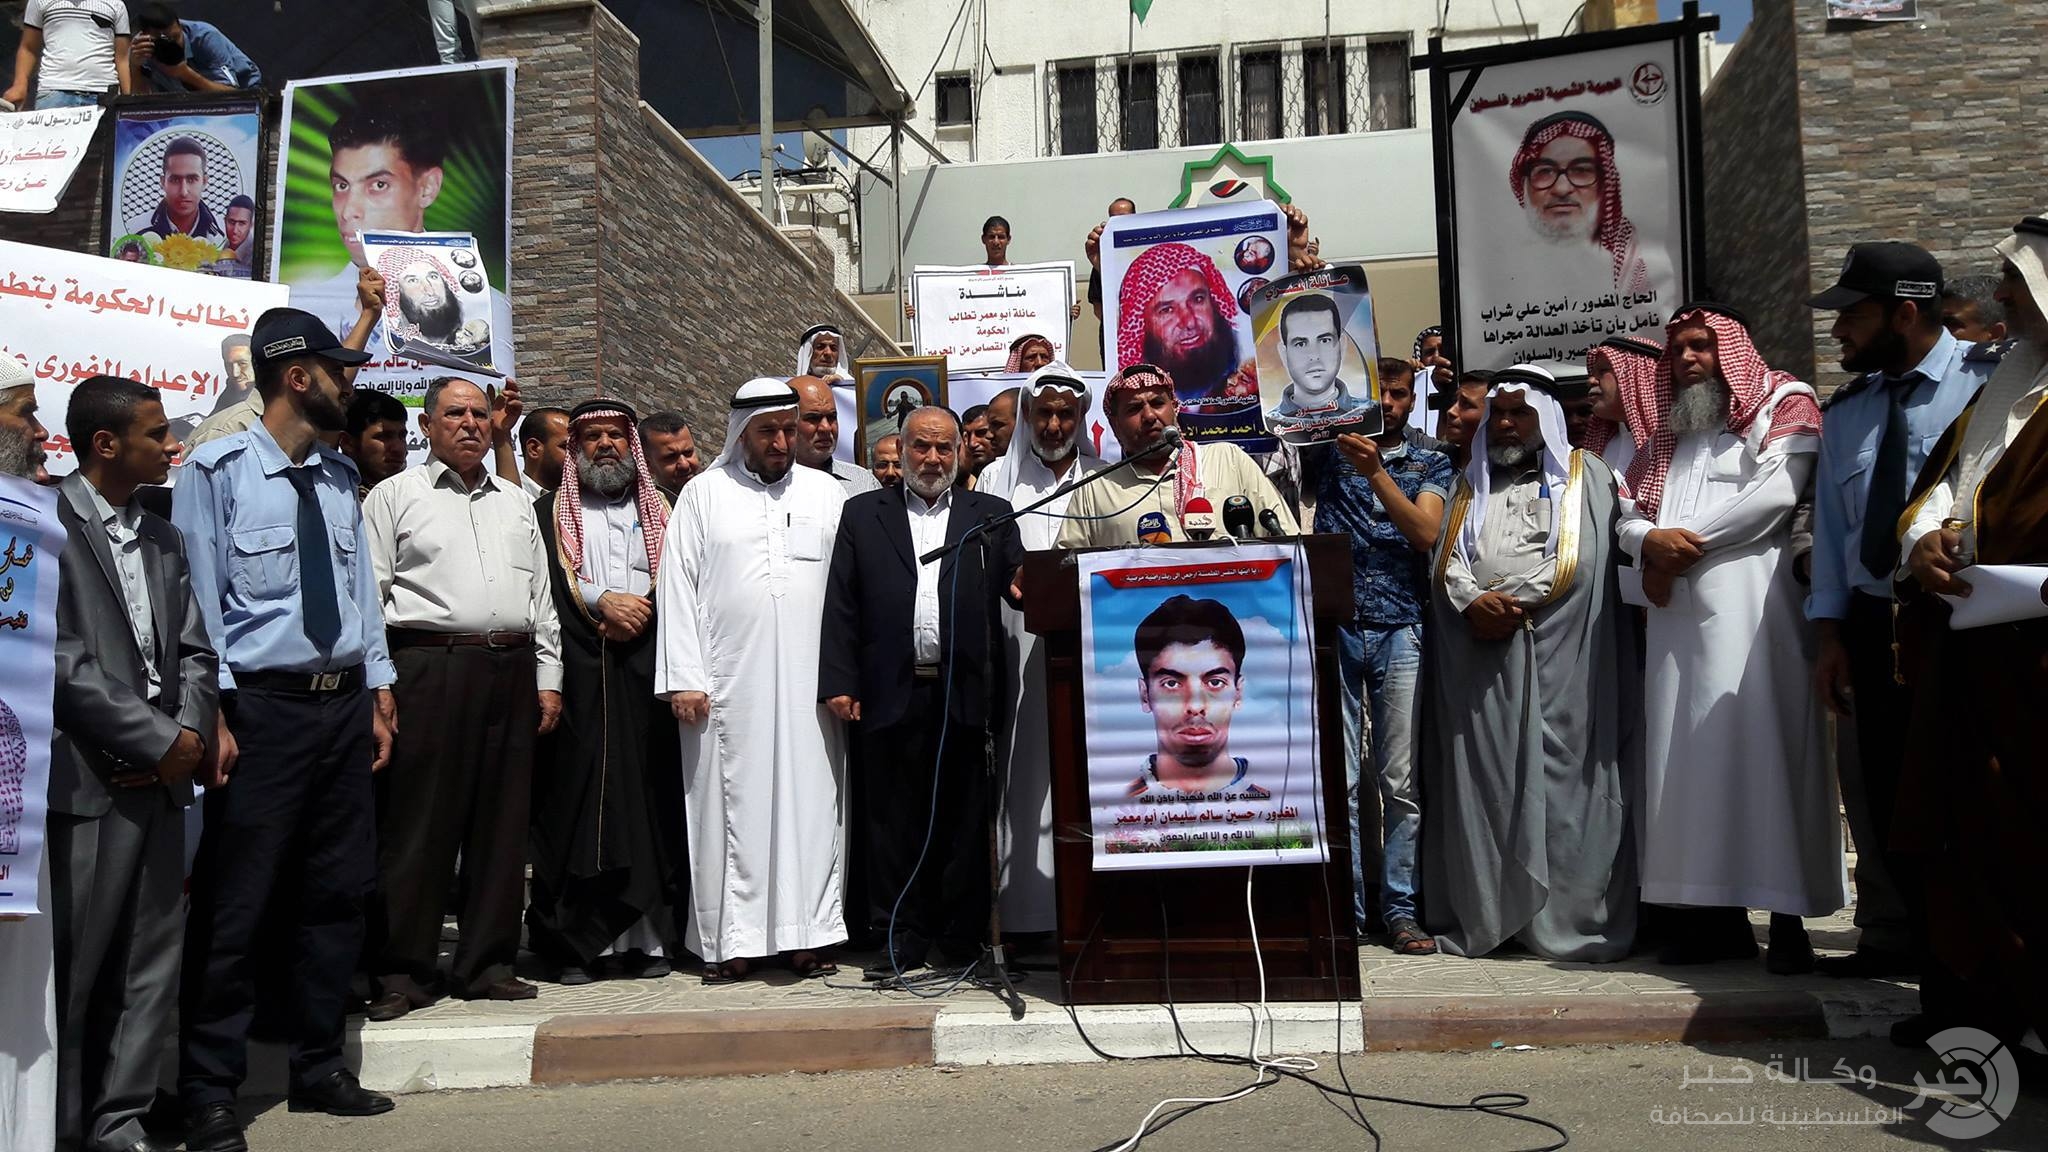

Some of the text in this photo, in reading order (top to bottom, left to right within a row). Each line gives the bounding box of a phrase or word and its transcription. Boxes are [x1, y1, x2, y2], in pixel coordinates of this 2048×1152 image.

[1470, 93, 1509, 112] فلسطين
[27, 113, 44, 125] الله
[44, 114, 71, 127] رسول
[73, 111, 92, 125] قال
[959, 285, 1026, 299] مناشدة
[0, 271, 249, 330] نطالب الحكومة بتط
[1543, 295, 1569, 317] أمين
[1580, 294, 1619, 314] المغدور
[1622, 290, 1657, 310] الحاج
[949, 310, 977, 324] تطالب
[978, 312, 997, 322] معمر
[1000, 309, 1012, 321] أبو
[1481, 303, 1513, 323] شراب
[1517, 302, 1540, 322] علي
[976, 326, 1009, 337] الحكومة
[1483, 312, 1660, 345] نأمل بأن تأخذ العدالة مجراها
[960, 345, 970, 356] من
[972, 342, 1006, 355] القصاص
[1201, 426, 1228, 435] محمد
[1231, 424, 1256, 434] احمد
[1114, 815, 1142, 826] معمر
[1143, 811, 1157, 826] أبو
[1160, 809, 1197, 825] سليمان
[1200, 809, 1224, 825] سالم
[1226, 809, 1255, 824] حسين
[1265, 806, 1299, 821] المغدور
